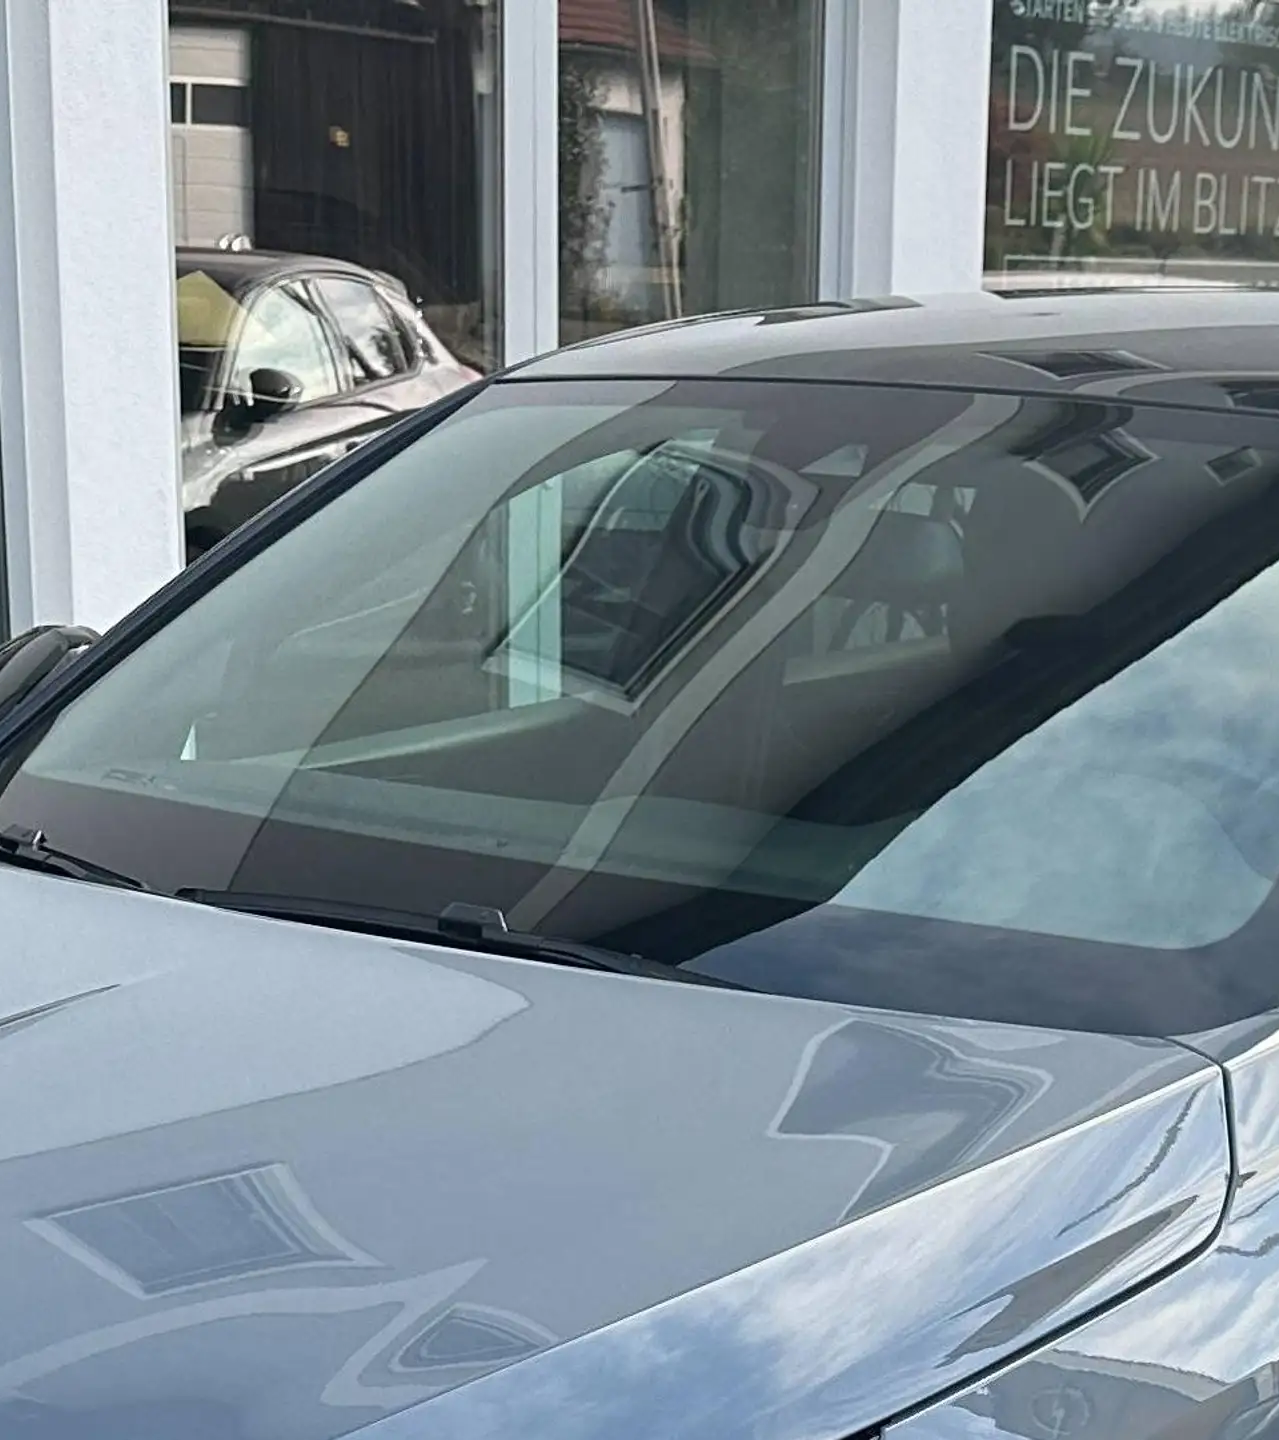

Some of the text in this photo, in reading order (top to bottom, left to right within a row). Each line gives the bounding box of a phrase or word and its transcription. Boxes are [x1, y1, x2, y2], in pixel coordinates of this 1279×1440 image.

[1008, 45, 1095, 136] DIE
[1004, 159, 1124, 230] LIEGT
[1135, 168, 1182, 233] IM
